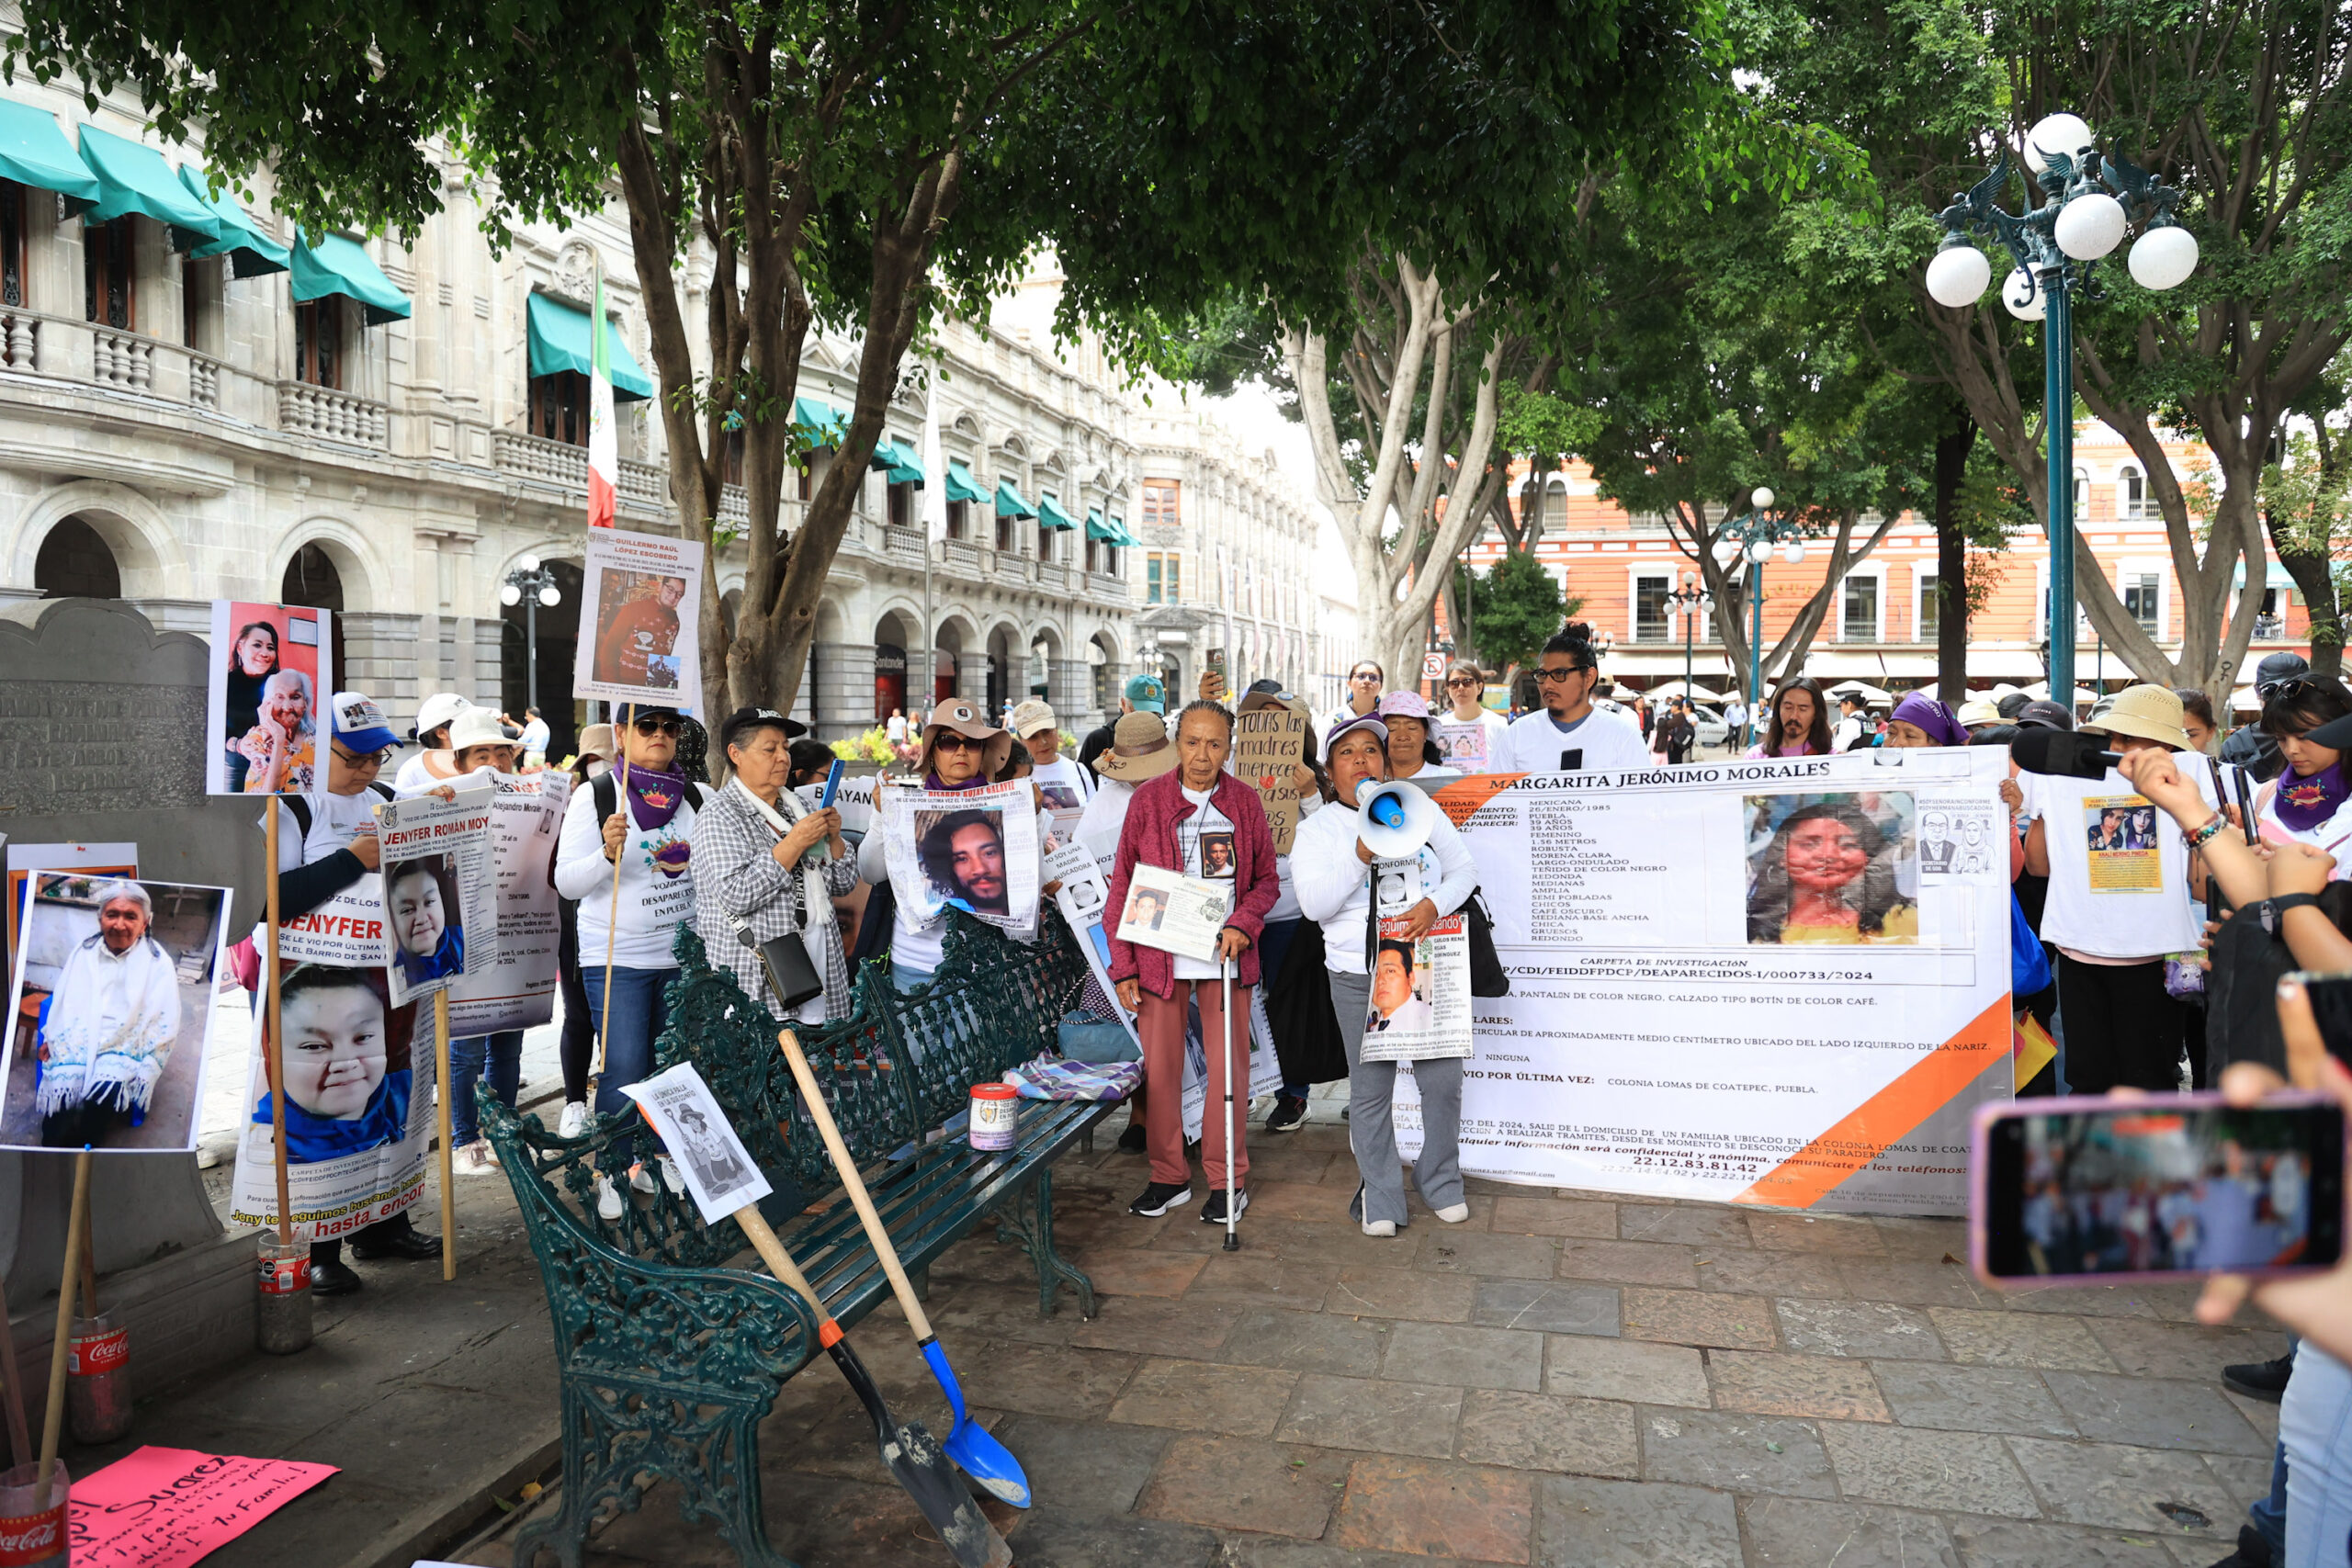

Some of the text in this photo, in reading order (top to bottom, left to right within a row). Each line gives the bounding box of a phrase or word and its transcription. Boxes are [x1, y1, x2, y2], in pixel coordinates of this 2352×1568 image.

[616, 538, 657, 548] GUILLERMO
[640, 551, 678, 561] ESCOBEDO
[1238, 712, 1302, 733] TODAS las
[1241, 736, 1299, 755] madres
[1490, 761, 1831, 789] MARGARITA JERÓNIMO MORALES
[963, 788, 984, 796] ROJAS
[384, 817, 489, 845] JENYFER ROMÁN MOY
[1056, 852, 1067, 861] SOY
[1068, 845, 1082, 854] UNA
[1054, 862, 1091, 880] BUSCADORA
[1057, 856, 1080, 869] MADRE
[1378, 859, 1417, 870] ONFORME
[306, 948, 341, 958] BARRIO
[1589, 992, 1624, 1000] COLOR
[1668, 995, 1718, 1003] CALZADO
[1750, 996, 1783, 1004] BOTÍN
[1787, 997, 1802, 1005] DE
[1804, 997, 1843, 1005] COLOR
[1847, 997, 1878, 1006] CAFÉ.
[1535, 1031, 1634, 1042] APROXIMADAMENTE
[1637, 1033, 1670, 1043] MEDIO
[1673, 1034, 1741, 1044] CENTÍMETRO
[1744, 1038, 1792, 1046] UBICADO
[1819, 1040, 1849, 1048] LADO
[1853, 1041, 1915, 1050] IZQUIERDO
[1486, 1054, 1530, 1062] NINGUNA
[1487, 1071, 1512, 1080] POR
[1516, 1071, 1563, 1082] ÚLTIMA
[1568, 1075, 1595, 1084] VEZ:
[1608, 1078, 1654, 1087] COLONIA
[1657, 1080, 1692, 1089] LOMAS
[1713, 1083, 1772, 1092] COATEPEC,
[1775, 1085, 1819, 1094] PUEBLA.
[1498, 1121, 1526, 1130] 2024,
[1584, 1126, 1636, 1136] DOMICILIO
[1681, 1131, 1730, 1142] FAMILIAR
[1735, 1134, 1783, 1145] UBICADO
[1824, 1140, 1874, 1151] COLONIA
[1879, 1144, 1917, 1152] LOMAS
[1506, 1129, 1554, 1138] REALIZAR
[1556, 1132, 1609, 1142] TRAMITES,
[1612, 1135, 1644, 1144] DESDE
[1668, 1139, 1722, 1149] MOMENTO
[1739, 1143, 1806, 1154] DESCONOCE
[1809, 1146, 1822, 1155] SU
[1826, 1147, 1888, 1159] PARADERO.
[1505, 1139, 1967, 1174] información será confidencial anónima, los teléfonos:
[1633, 1156, 1757, 1173] 22.12.83.81.42
[293, 1192, 331, 1201] información
[232, 1210, 263, 1226] Jeny
[291, 1206, 347, 1224] eguimos
[350, 1186, 400, 1213] buscando
